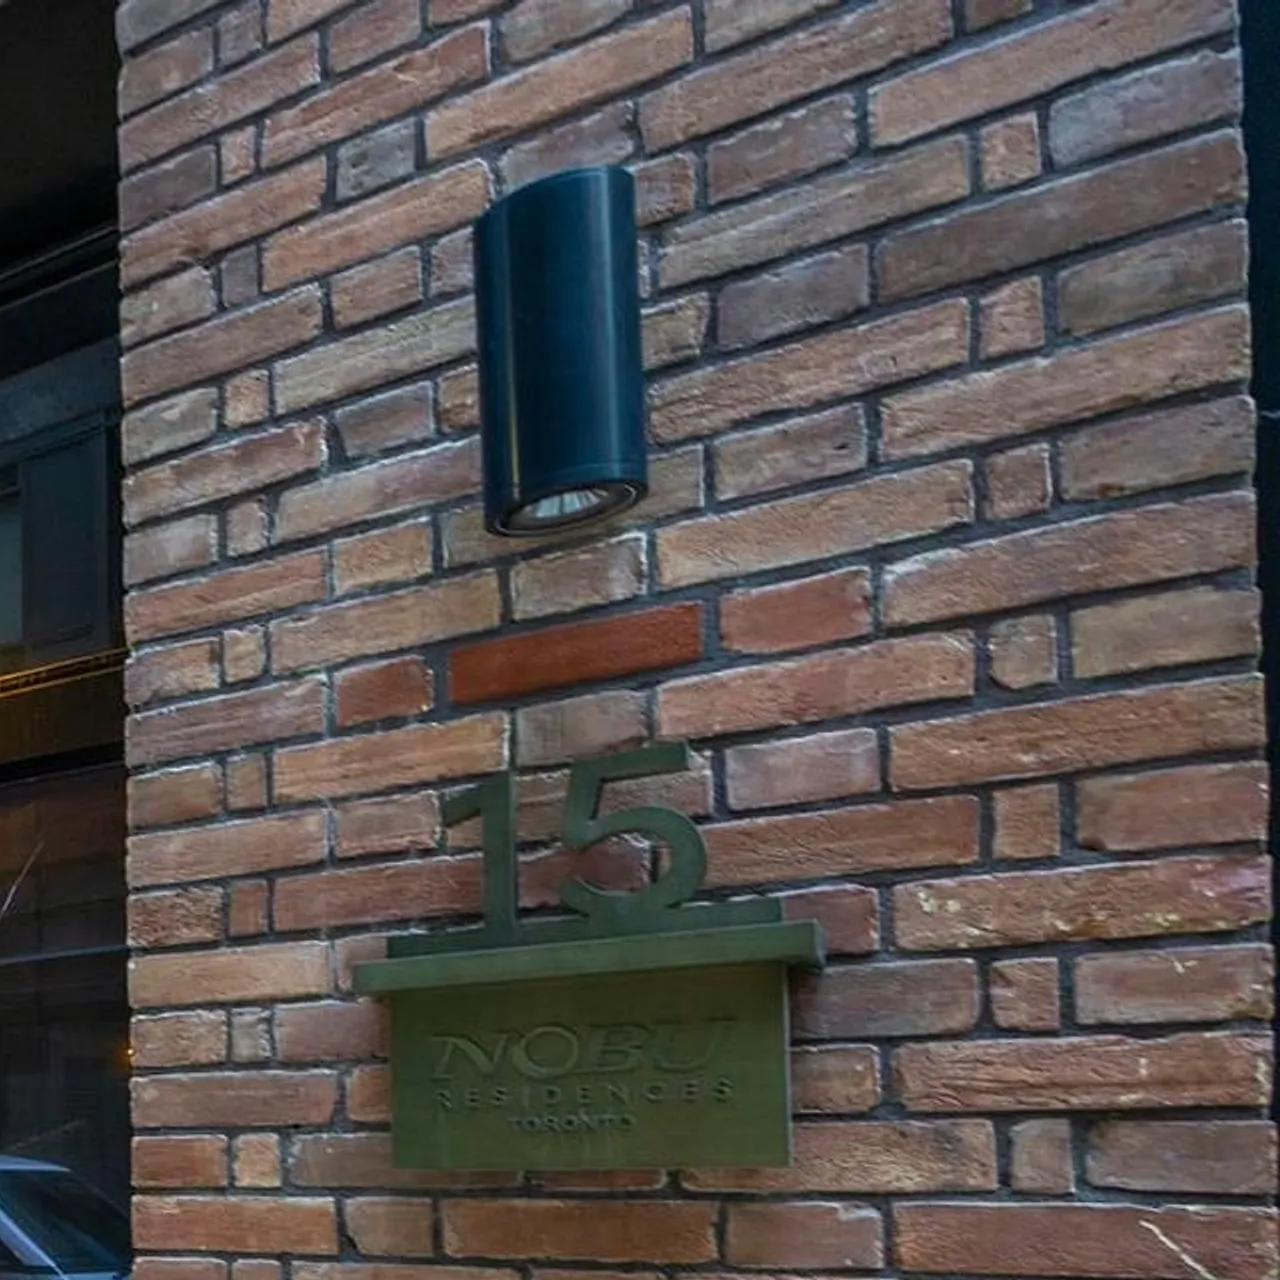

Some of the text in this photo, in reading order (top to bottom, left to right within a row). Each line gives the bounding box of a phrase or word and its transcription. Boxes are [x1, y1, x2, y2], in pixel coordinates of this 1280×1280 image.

[442, 741, 707, 928] 15
[429, 1016, 738, 1080] NOBU
[436, 1075, 736, 1109] RESIDENCES
[508, 1110, 638, 1133] TORONTO
